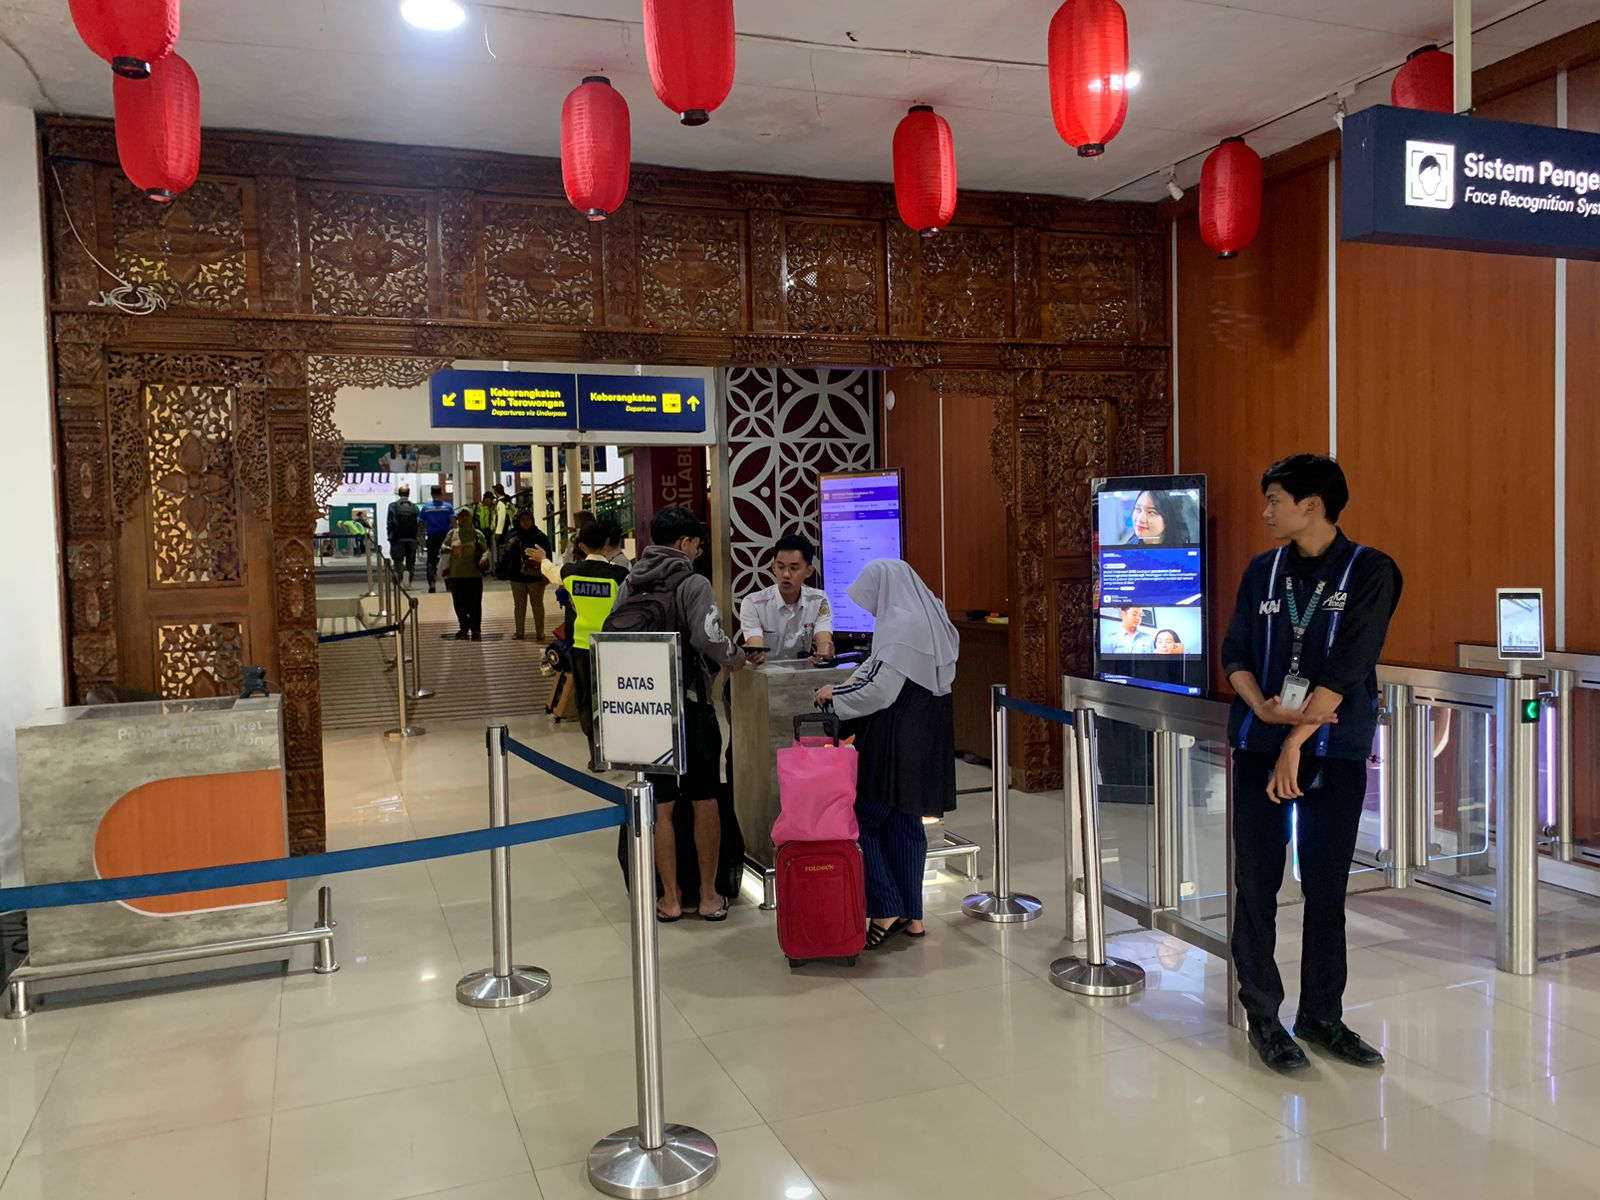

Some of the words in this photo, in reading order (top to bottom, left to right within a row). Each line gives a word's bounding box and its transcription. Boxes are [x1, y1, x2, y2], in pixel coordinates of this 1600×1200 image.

[1464, 152, 1534, 184] Sistem
[1464, 186, 1497, 205] Face
[1499, 189, 1574, 213] Recognition
[490, 387, 561, 399] Keberangkatan
[590, 392, 657, 403] Keberangkatan
[491, 397, 506, 407] via
[507, 397, 565, 409] Terowongan
[626, 405, 657, 413] Departures
[491, 408, 525, 417] Departures
[574, 582, 609, 596] SATPAM
[1259, 599, 1281, 615] KAI
[617, 677, 655, 690] BATAS
[602, 701, 673, 716] PENGANTAR
